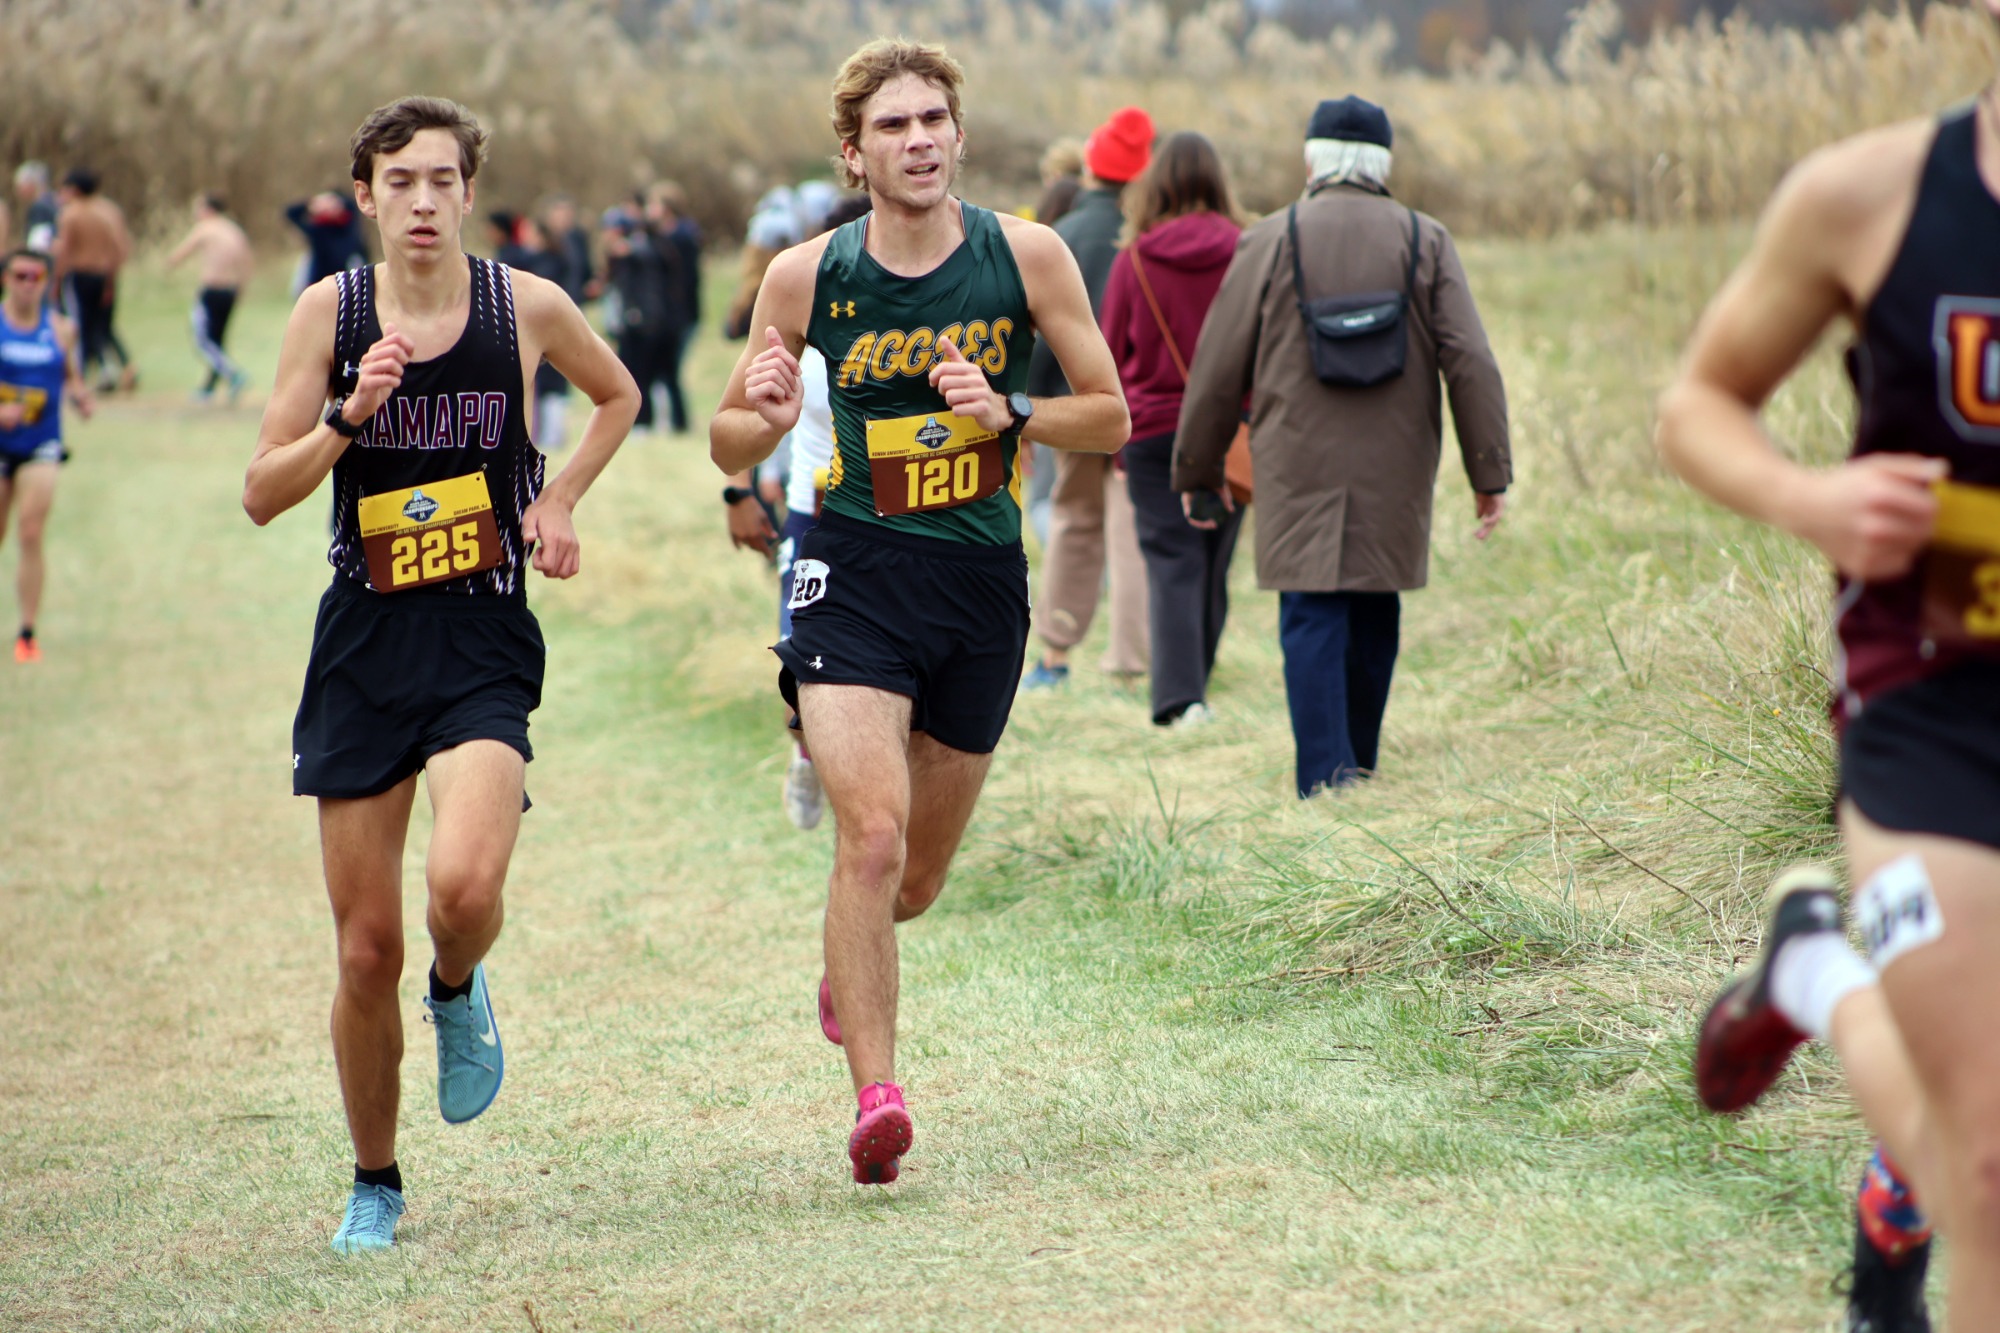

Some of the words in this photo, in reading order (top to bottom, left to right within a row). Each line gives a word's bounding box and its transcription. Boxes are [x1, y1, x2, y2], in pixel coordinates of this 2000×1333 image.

[346, 391, 507, 450] AMAPO
[904, 451, 980, 509] 120
[391, 520, 480, 587] 225
